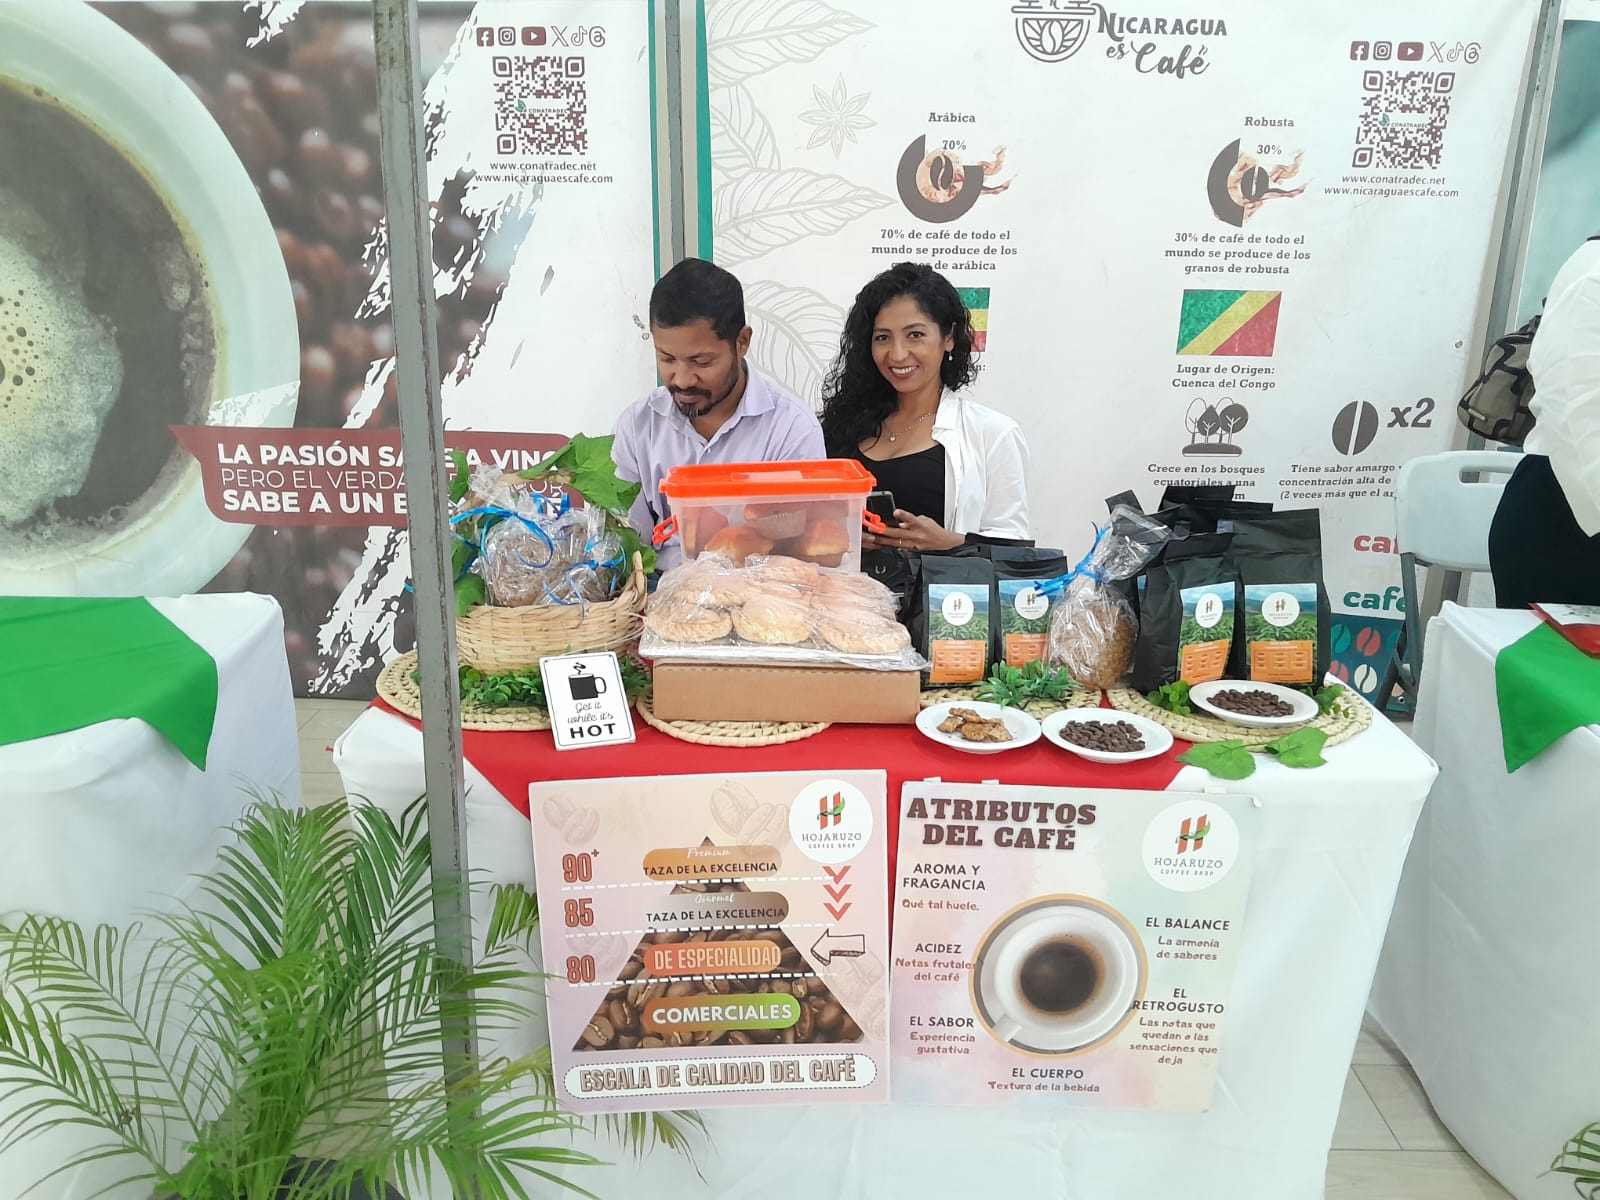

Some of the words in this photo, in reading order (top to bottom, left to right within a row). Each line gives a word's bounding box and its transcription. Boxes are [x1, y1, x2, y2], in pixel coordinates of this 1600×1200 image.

[1106, 43, 1129, 60] es
[1130, 40, 1210, 79] Café
[928, 112, 976, 124] Arábica
[1244, 116, 1295, 128] Robusta
[942, 140, 967, 151] 70%
[1256, 144, 1282, 156] 30%
[489, 160, 597, 171] www.conatradec.net
[475, 173, 613, 184] www.nicaraguaescafe.com
[1341, 175, 1446, 185] www.conatradec.net
[1324, 186, 1459, 198] www.nicaraguaescafe.com
[880, 229, 905, 239] 70%
[908, 229, 922, 239] de
[925, 229, 950, 239] café
[954, 230, 968, 240] de
[971, 230, 996, 240] todo
[999, 230, 1011, 240] el
[1174, 232, 1198, 242] 30%
[1201, 233, 1216, 243] de
[1219, 234, 1244, 243] café
[1248, 234, 1262, 244] de
[1265, 235, 1290, 244] todo
[1293, 235, 1305, 244] el
[871, 245, 913, 254] mundo
[916, 246, 929, 254] se
[932, 246, 980, 257] produce
[983, 246, 997, 255] de
[1000, 246, 1018, 255] los
[1165, 248, 1205, 257] mundo
[1208, 250, 1221, 258] se
[1224, 249, 1273, 260] produce
[1276, 250, 1290, 259] de
[1293, 250, 1311, 260] los
[934, 260, 949, 270] de
[952, 260, 996, 270] arábica
[1184, 264, 1224, 274] granos
[1228, 264, 1242, 273] de
[1245, 264, 1290, 274] robusta
[1176, 364, 1211, 376] Lugar
[1214, 364, 1228, 374] de
[1231, 364, 1275, 376] Origen:
[1172, 378, 1215, 388] Cuenca
[1218, 378, 1236, 388] del
[1239, 379, 1276, 390] Congo
[1387, 397, 1435, 428] x2
[217, 443, 253, 465] LA
[259, 440, 370, 467] PASIÓN
[1148, 464, 1182, 473] Crece
[1201, 464, 1217, 473] los
[1220, 464, 1265, 476] bosques
[1291, 464, 1321, 472] Tiene
[1324, 464, 1354, 472] sabor
[1355, 464, 1396, 474] amargo
[221, 468, 285, 488] PERO
[293, 470, 322, 489] EL
[1278, 476, 1354, 486] concentración
[1356, 476, 1375, 484] alta
[1378, 476, 1392, 484] de
[1280, 490, 1290, 500] (2
[1324, 490, 1346, 498] más
[1348, 490, 1368, 499] que
[1370, 488, 1380, 497] el
[223, 488, 301, 513] SABE
[309, 491, 332, 513] A
[339, 492, 384, 514] UN
[575, 702, 592, 714] Get
[594, 701, 602, 710] it
[568, 712, 598, 724] while
[570, 723, 616, 739] HOT
[906, 797, 1097, 825] ATRIBUTOS
[802, 833, 862, 842] HOJARUZO
[922, 823, 983, 847] DEL
[994, 825, 1076, 851] CAFÉ
[686, 848, 731, 859] Premium
[644, 866, 674, 876] TAZA
[676, 865, 690, 874] DE
[693, 864, 708, 874] LA
[710, 862, 778, 873] EXCELENCIA
[1154, 857, 1223, 869] HOJARUZO
[913, 863, 967, 876] AROMA
[971, 864, 981, 876] Y
[903, 877, 986, 891] FRAGANCIA
[902, 898, 924, 910] Qué
[928, 900, 944, 910] tal
[946, 900, 980, 912] huele.
[564, 898, 594, 928] 85
[646, 912, 678, 922] TAZA
[681, 911, 695, 920] DE
[698, 910, 713, 920] LA
[716, 908, 786, 919] EXCELENCIA
[1145, 917, 1160, 928] EL
[1164, 918, 1230, 931] BALANCE
[915, 943, 962, 954] ACIDEZ
[1158, 936, 1173, 946] La
[1175, 937, 1220, 949] armonía
[654, 950, 673, 970] DE
[677, 945, 782, 969] ESPECIALIDAD
[1156, 950, 1171, 959] de
[1174, 951, 1217, 961] sabores
[566, 954, 596, 984] 80
[895, 958, 929, 968] Notas
[914, 972, 931, 981] del
[934, 972, 960, 982] café
[1173, 988, 1187, 999] EL
[1132, 1000, 1224, 1014] RETROGUSTO
[652, 1004, 793, 1025] COMERCIALES
[910, 1016, 924, 1026] EL
[928, 1016, 974, 1028] SABOR
[1139, 1016, 1159, 1028] Las
[1162, 1018, 1192, 1029] notas
[1196, 1021, 1216, 1030] que
[910, 1032, 976, 1043] Experiencia
[1142, 1031, 1182, 1041] quedan
[1194, 1032, 1209, 1042] las
[917, 1046, 970, 1055] gustativa
[1129, 1043, 1195, 1053] sensaciones
[1198, 1046, 1218, 1055] que
[580, 1067, 652, 1092] ESCALA
[656, 1066, 681, 1088] DE
[686, 1061, 765, 1086] CALIDAD
[770, 1060, 804, 1084] DEL
[808, 1053, 856, 1083] CAFÉ
[1012, 1068, 1025, 1078] EL
[1030, 1068, 1084, 1079] CUERPO
[988, 1081, 1032, 1090] Textura
[1034, 1082, 1048, 1091] de
[1051, 1082, 1061, 1091] la
[1064, 1083, 1100, 1092] bebida
